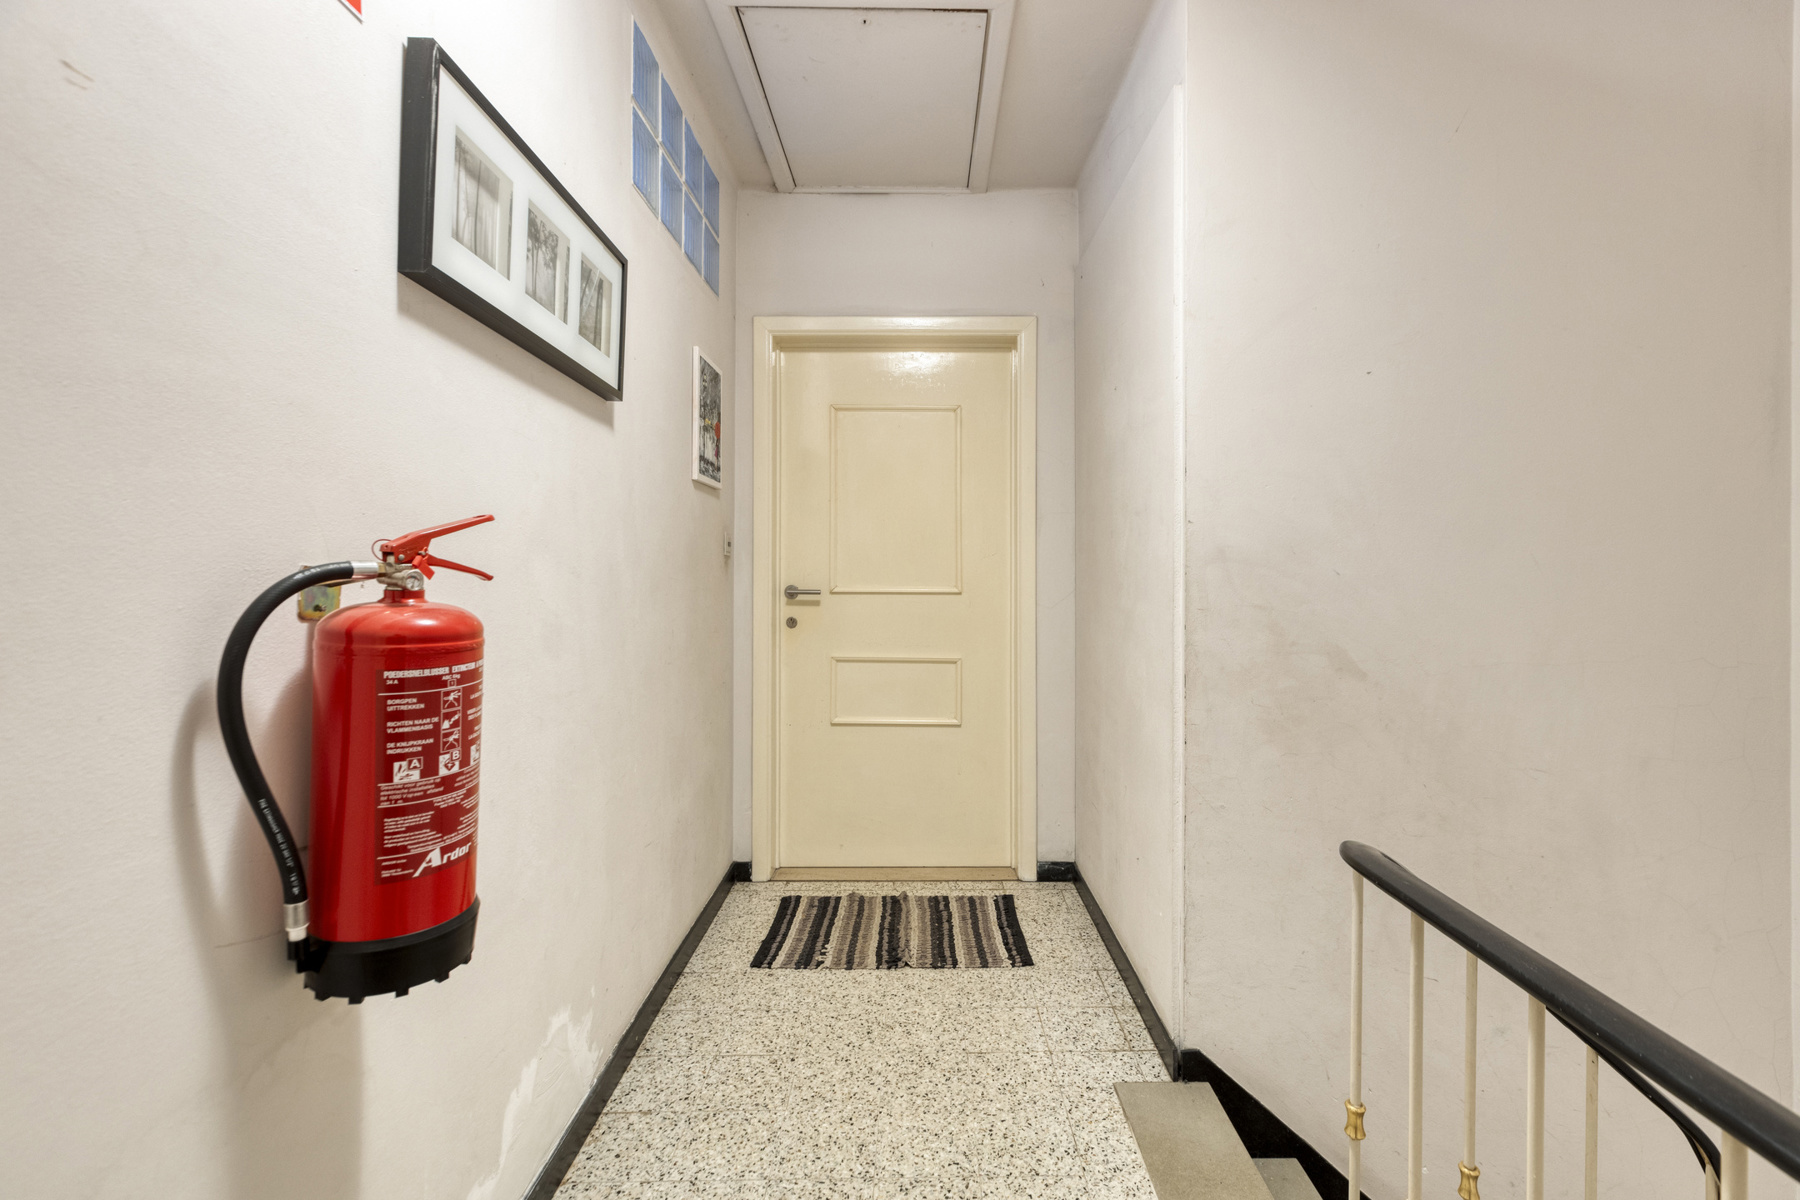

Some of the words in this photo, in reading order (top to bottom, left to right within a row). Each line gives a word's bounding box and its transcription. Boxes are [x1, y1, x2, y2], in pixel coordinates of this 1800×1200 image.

[387, 704, 425, 712] UITTREKKEN
[387, 724, 434, 734] VLAMMENBASIS
[396, 738, 434, 747] KNIJPKRAAN
[386, 746, 422, 754] INDRUKKEN
[452, 750, 460, 760] B
[410, 759, 420, 769] A
[412, 842, 472, 878] Ardor
